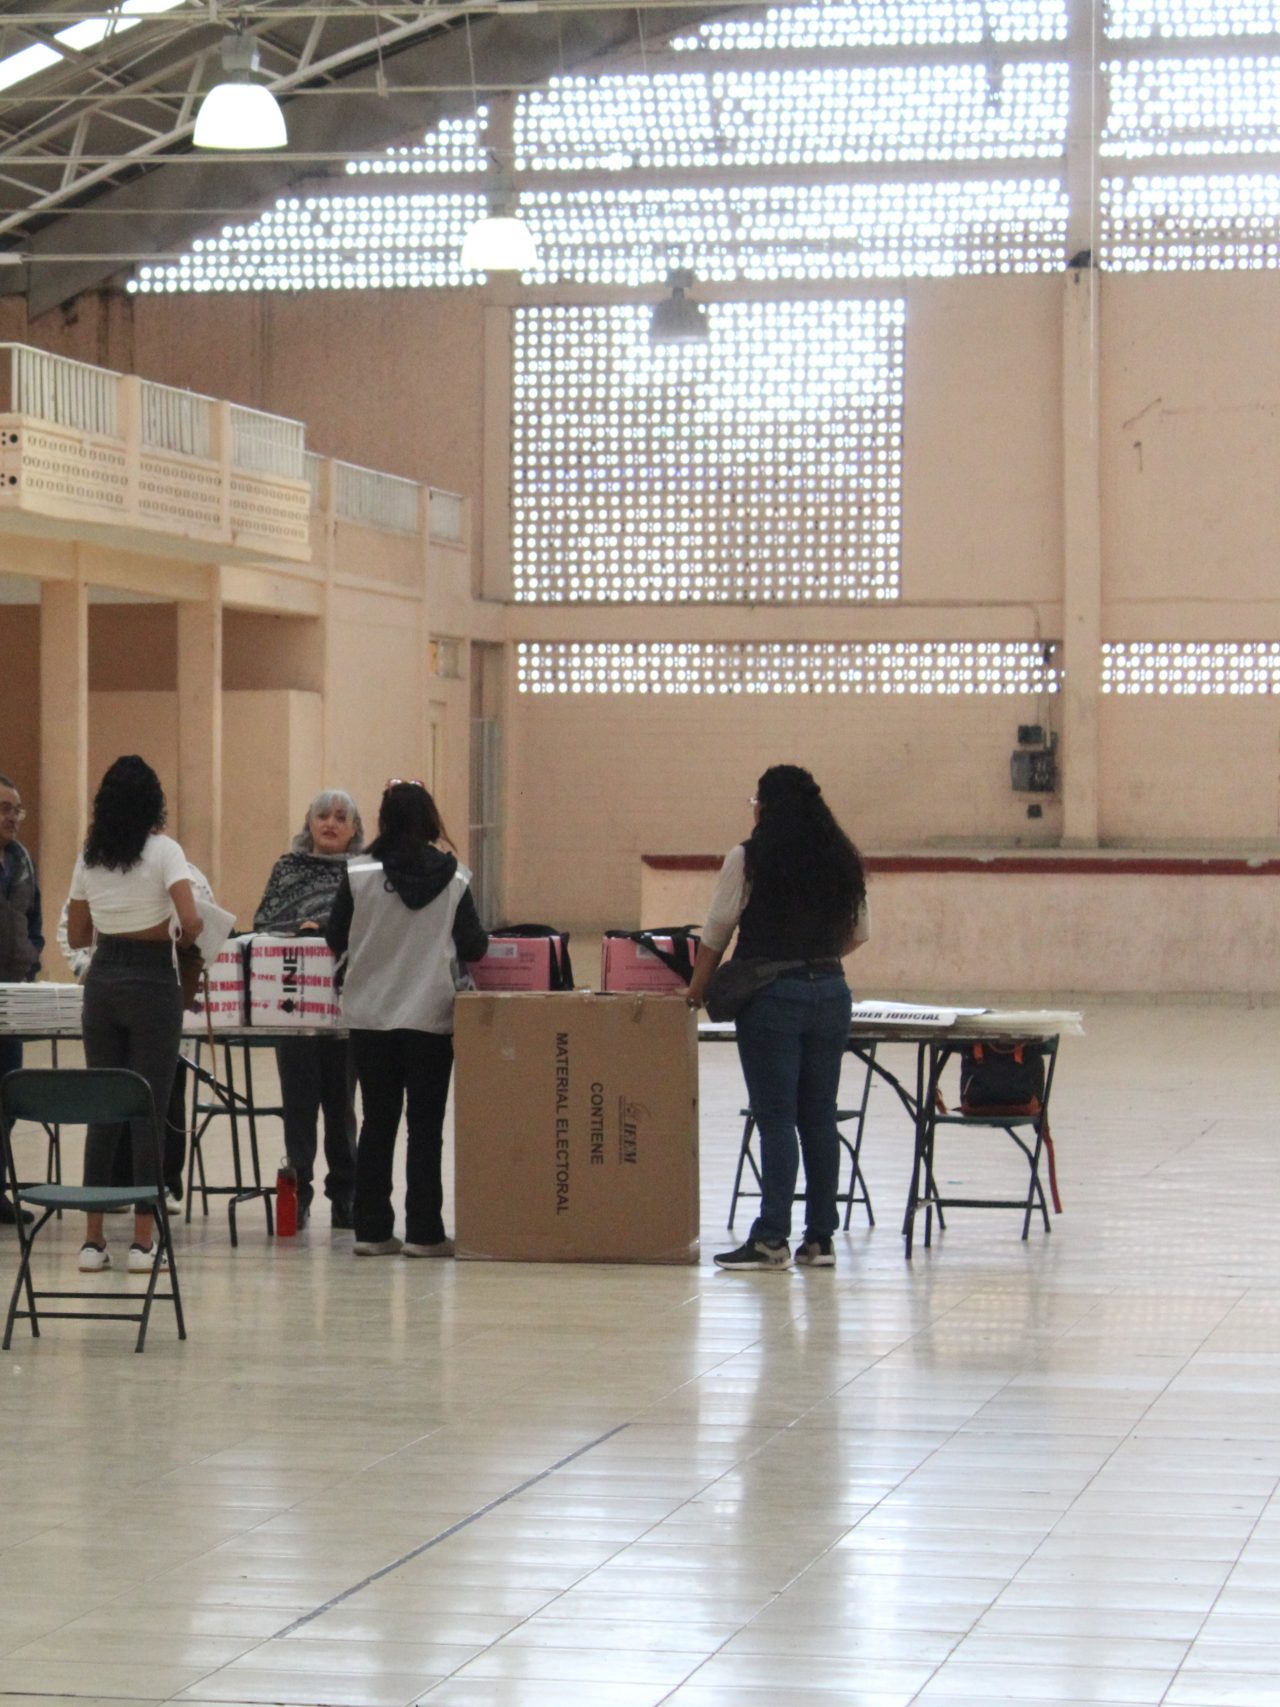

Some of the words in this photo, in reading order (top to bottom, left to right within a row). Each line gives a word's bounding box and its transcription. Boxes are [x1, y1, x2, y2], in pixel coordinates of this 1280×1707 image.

[283, 947, 298, 993] INE
[851, 1011, 882, 1019] ODER
[885, 1012, 940, 1021] JUDICIAL
[556, 1032, 569, 1112] MATERIAL
[590, 1082, 603, 1165] CONTIENE
[556, 1118, 570, 1215] ELECTORAL
